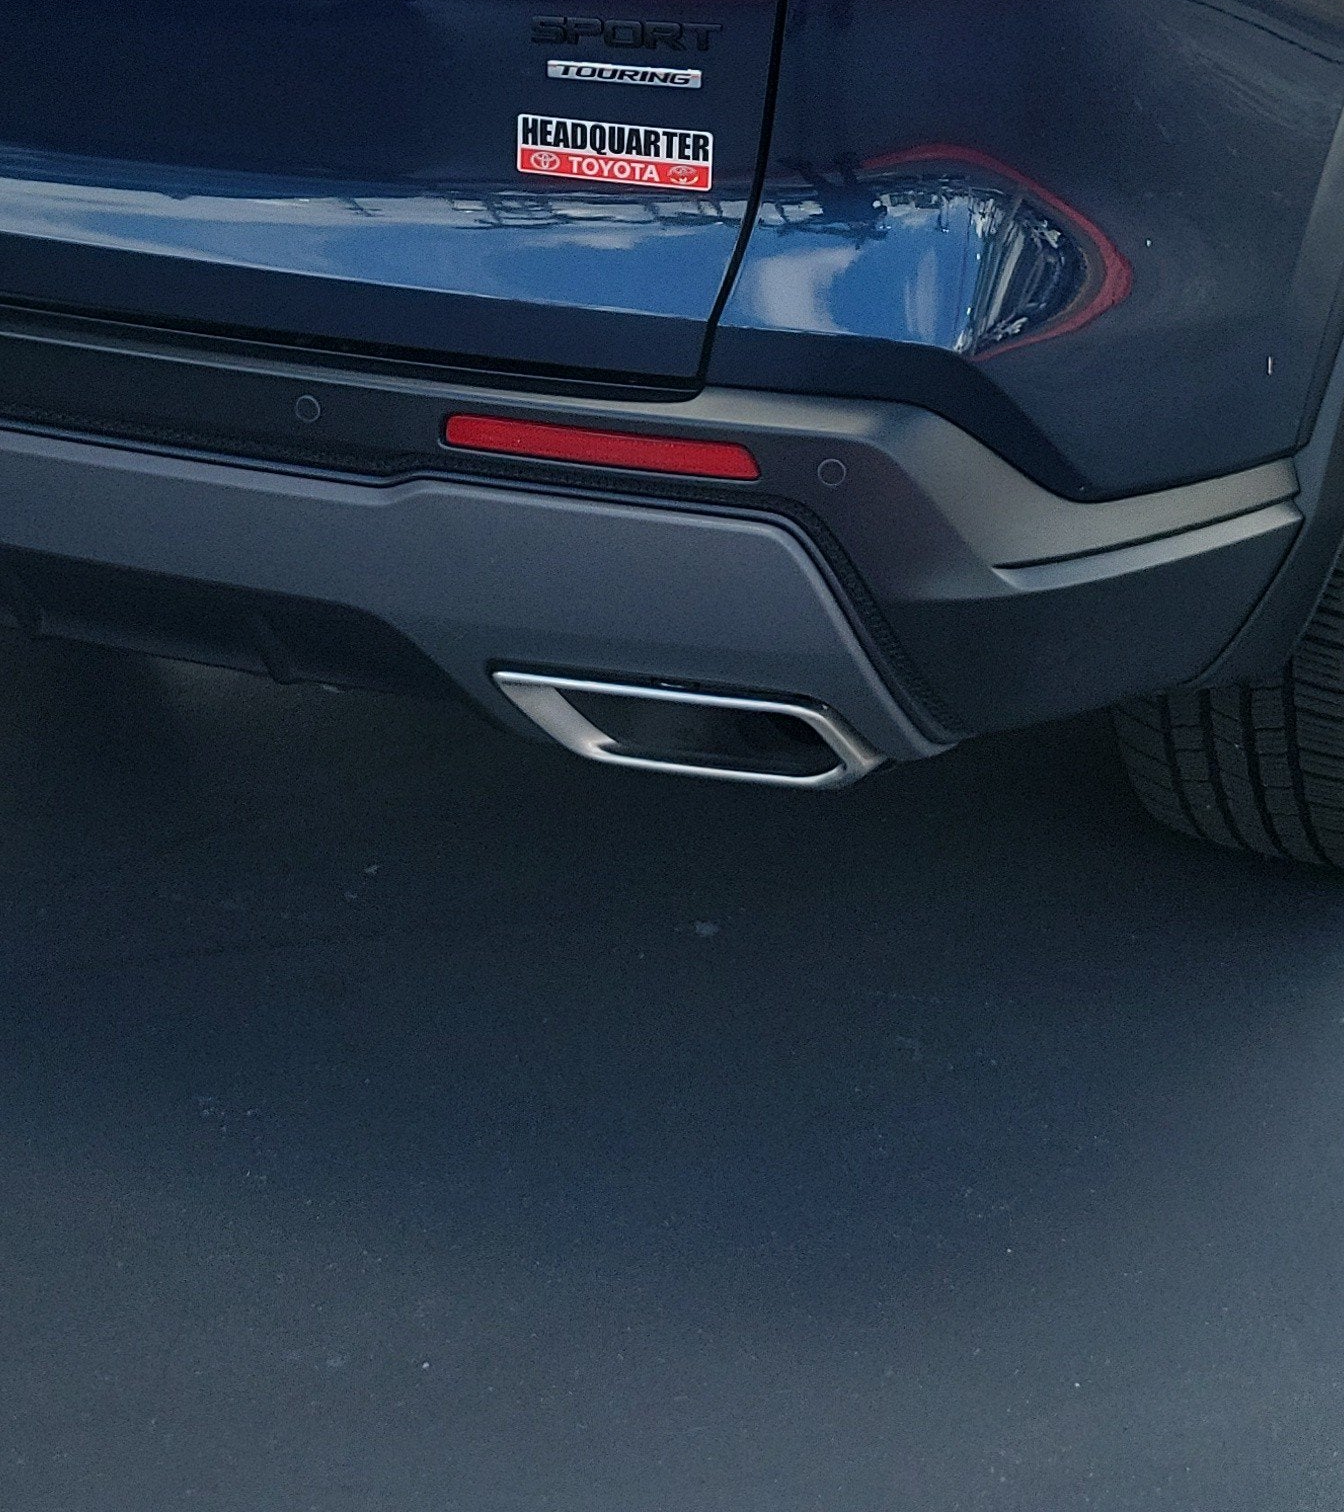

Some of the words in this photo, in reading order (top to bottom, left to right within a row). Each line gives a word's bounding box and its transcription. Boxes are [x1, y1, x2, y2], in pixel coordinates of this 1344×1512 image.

[531, 16, 723, 52] SPORT
[556, 64, 692, 86] TOURING
[522, 117, 709, 162] HEADQUARTER
[567, 156, 660, 183] TOYOTA
